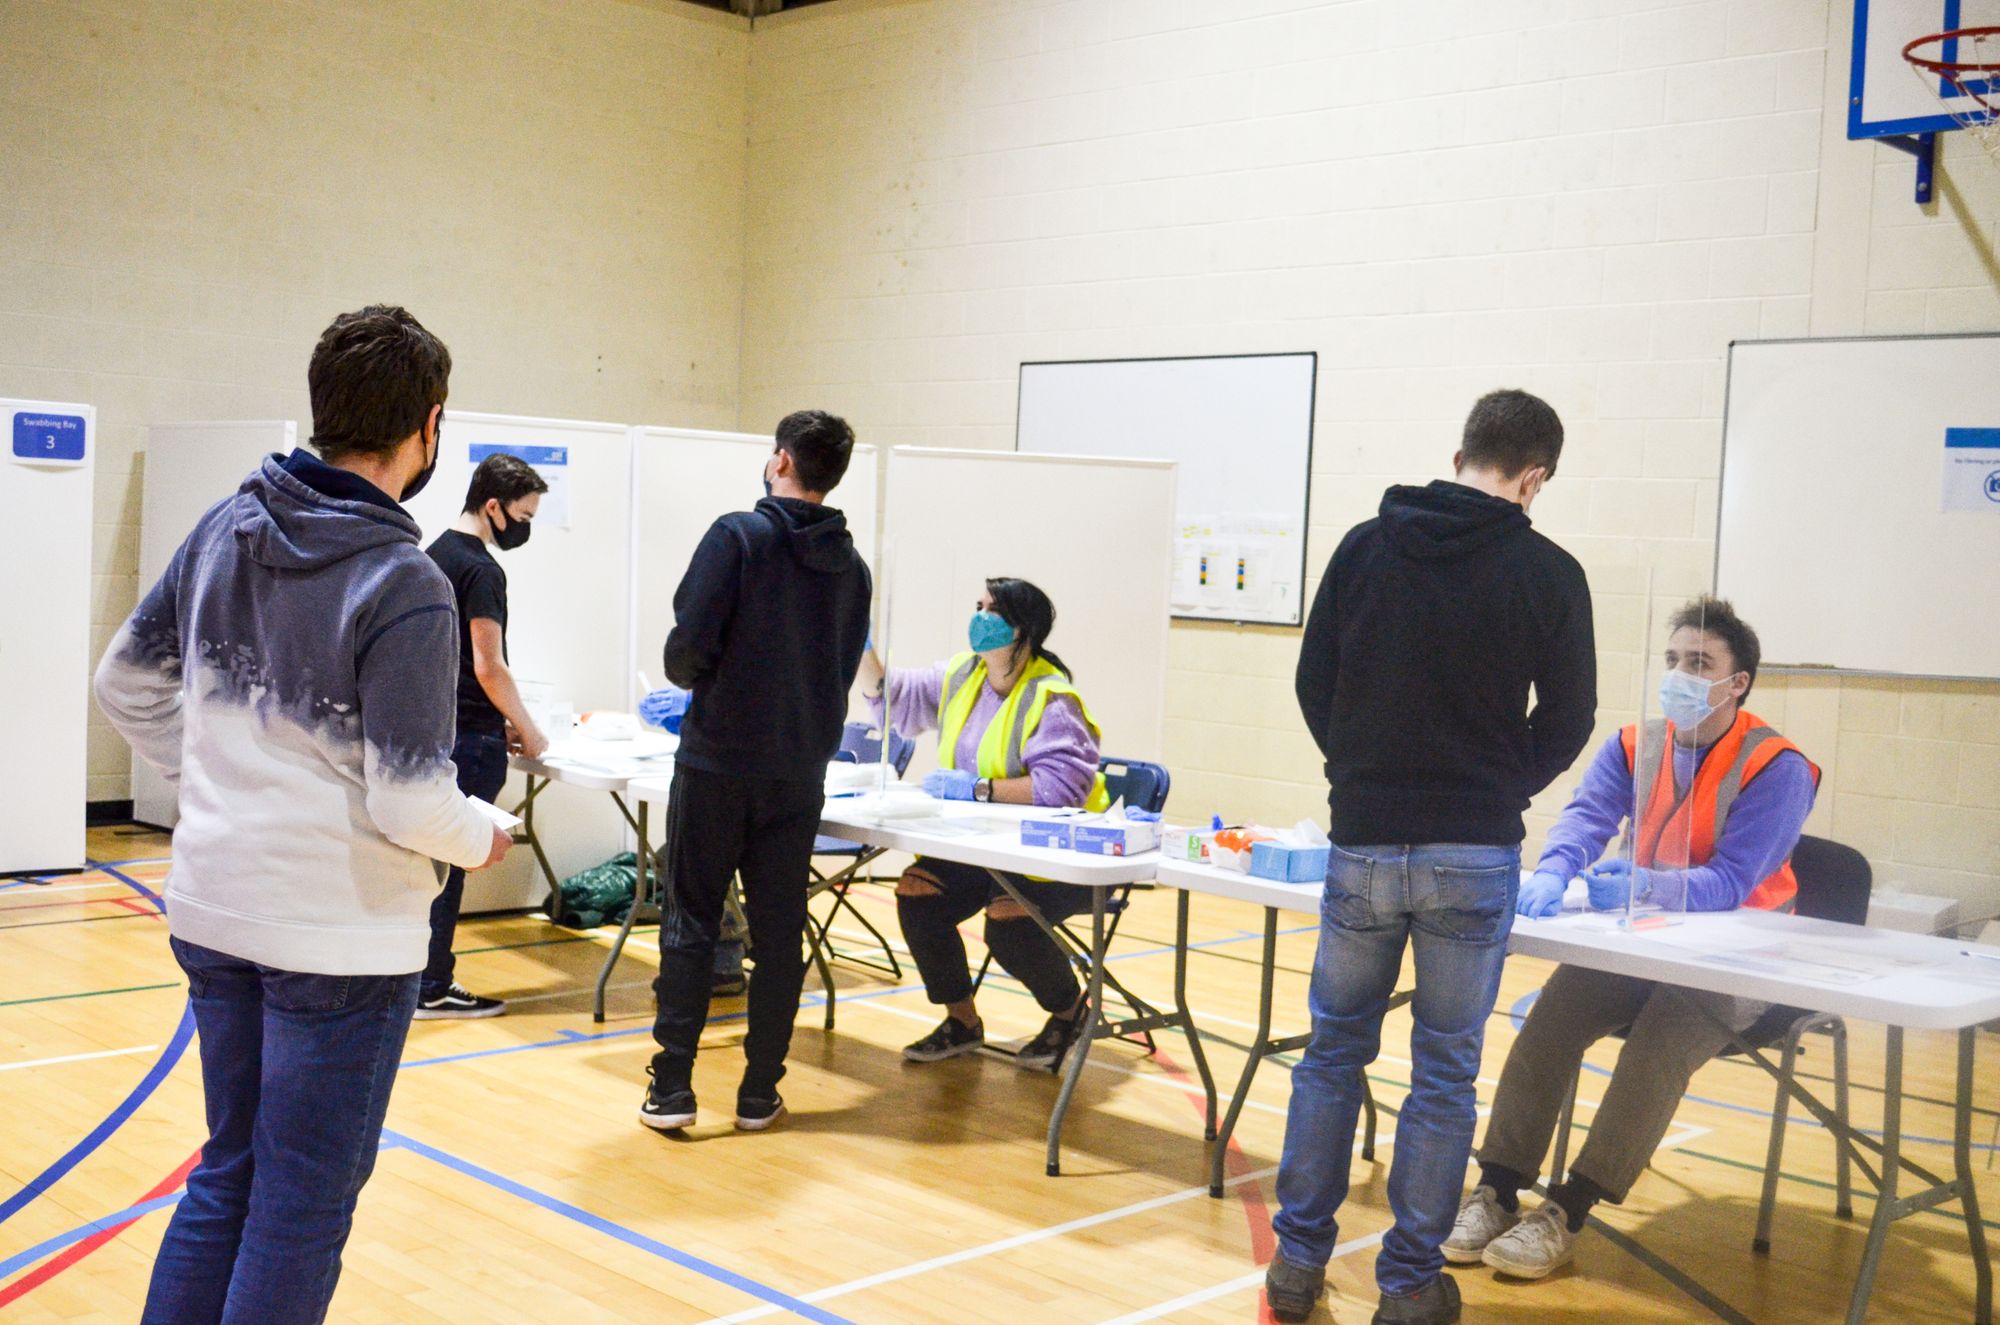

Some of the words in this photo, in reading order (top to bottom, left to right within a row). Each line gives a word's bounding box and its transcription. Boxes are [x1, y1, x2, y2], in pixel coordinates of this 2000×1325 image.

[23, 417, 61, 429] Swabbing
[63, 420, 77, 430] Bay
[46, 435, 55, 449] 3
